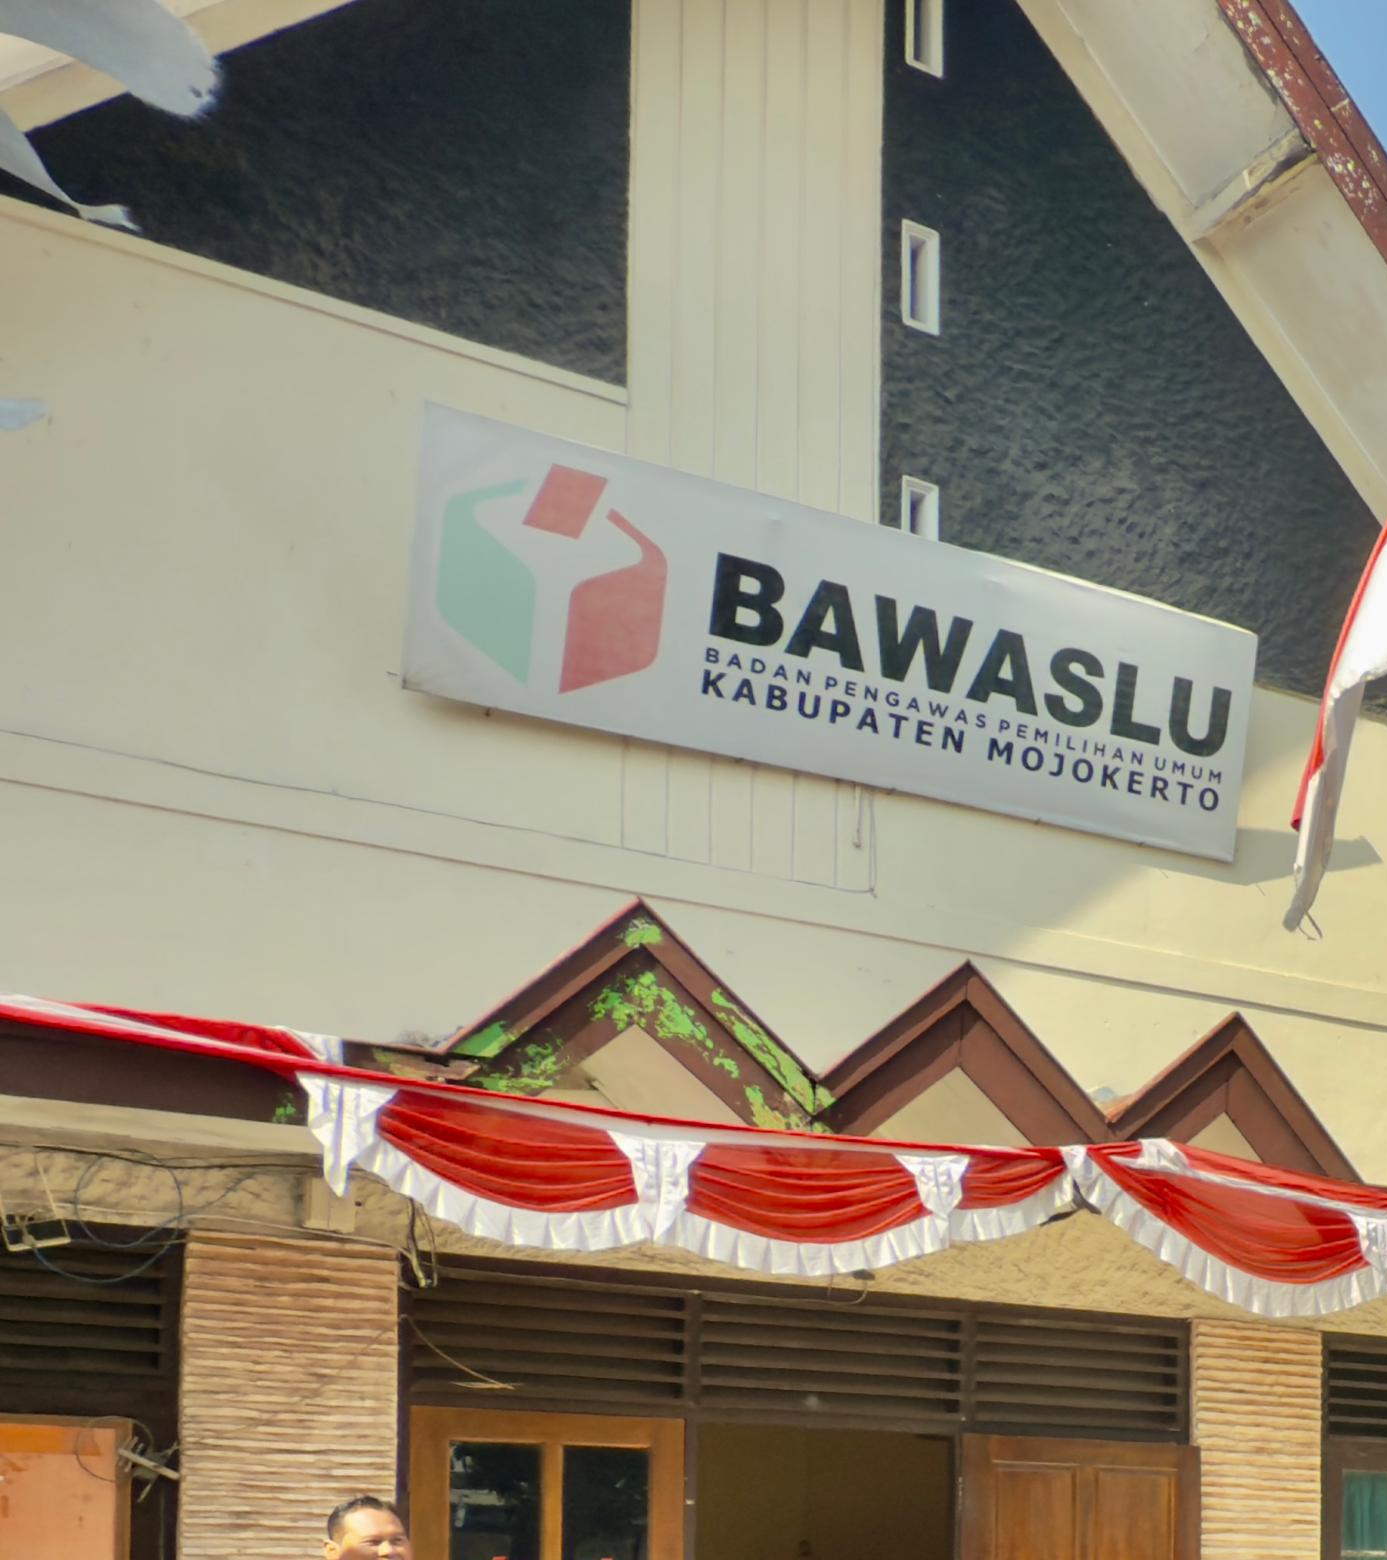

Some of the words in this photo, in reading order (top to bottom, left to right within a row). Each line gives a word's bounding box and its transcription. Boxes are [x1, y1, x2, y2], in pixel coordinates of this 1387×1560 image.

[705, 647, 811, 686] BADAN
[825, 675, 986, 728] PENGAWAS
[999, 719, 1143, 766] PEMILIHAN
[1155, 757, 1222, 784] UMUM
[709, 552, 1231, 757] BAWASLU
[702, 669, 965, 753] KABUPATEN
[987, 738, 1219, 811] MOJOKERTO
